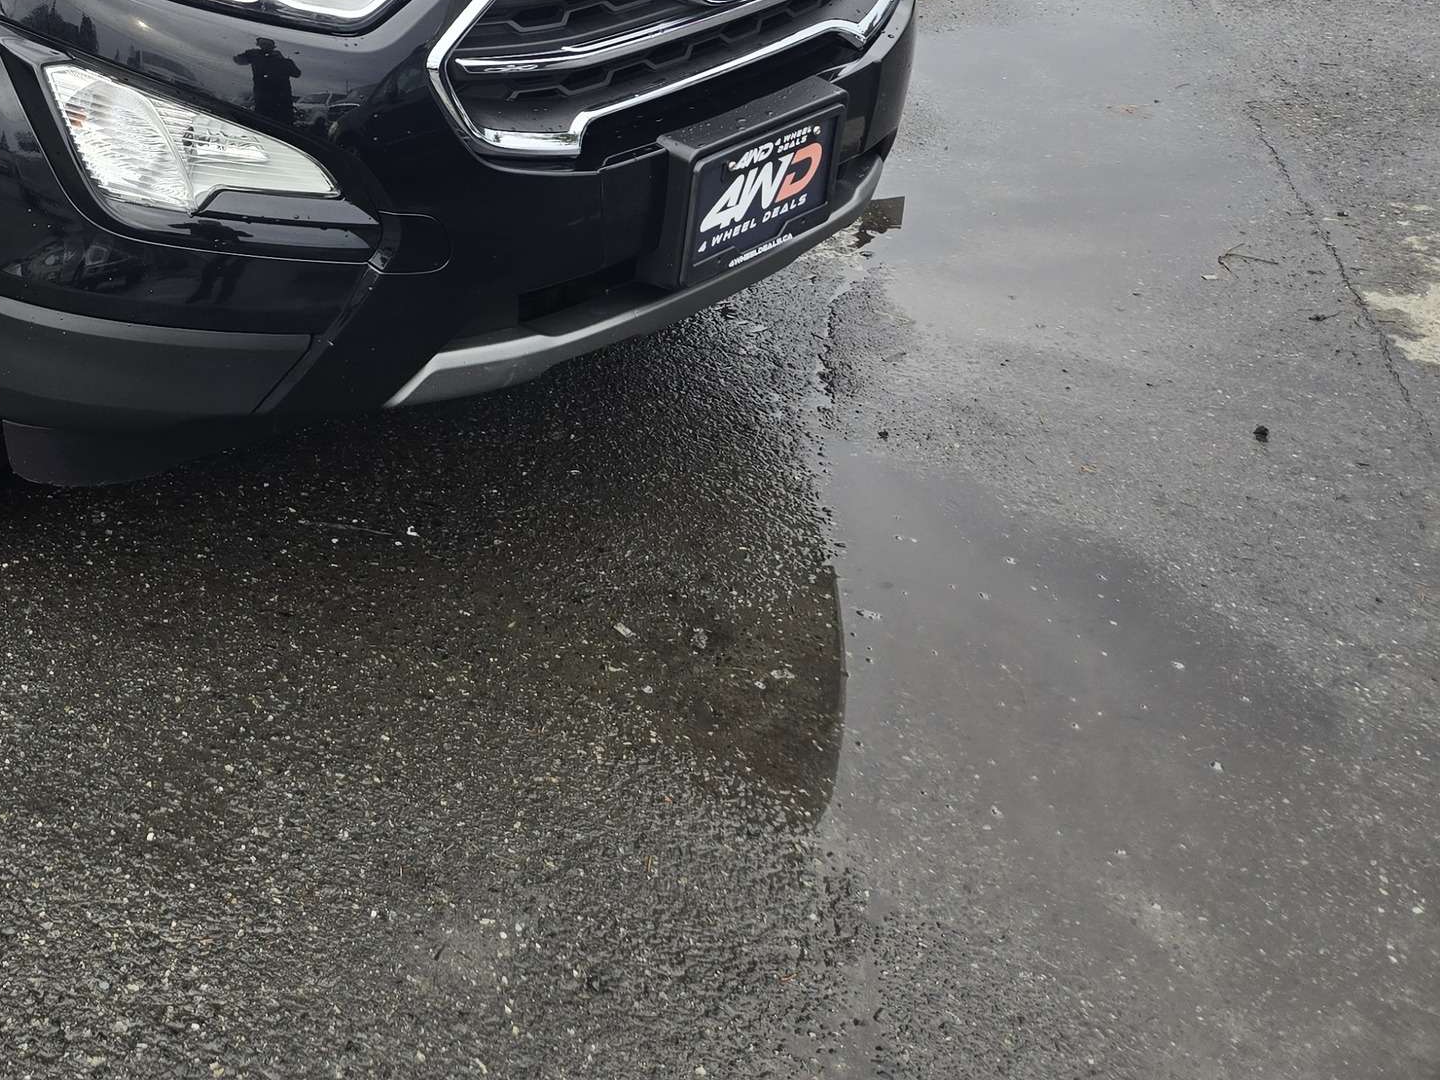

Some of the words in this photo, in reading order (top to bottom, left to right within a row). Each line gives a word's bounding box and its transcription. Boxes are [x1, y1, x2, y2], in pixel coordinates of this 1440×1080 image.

[777, 135, 808, 153] DEALS
[700, 142, 823, 233] 4WD
[697, 240, 707, 253] 4
[711, 217, 757, 247] WHEEL
[762, 193, 808, 223] DEALS
